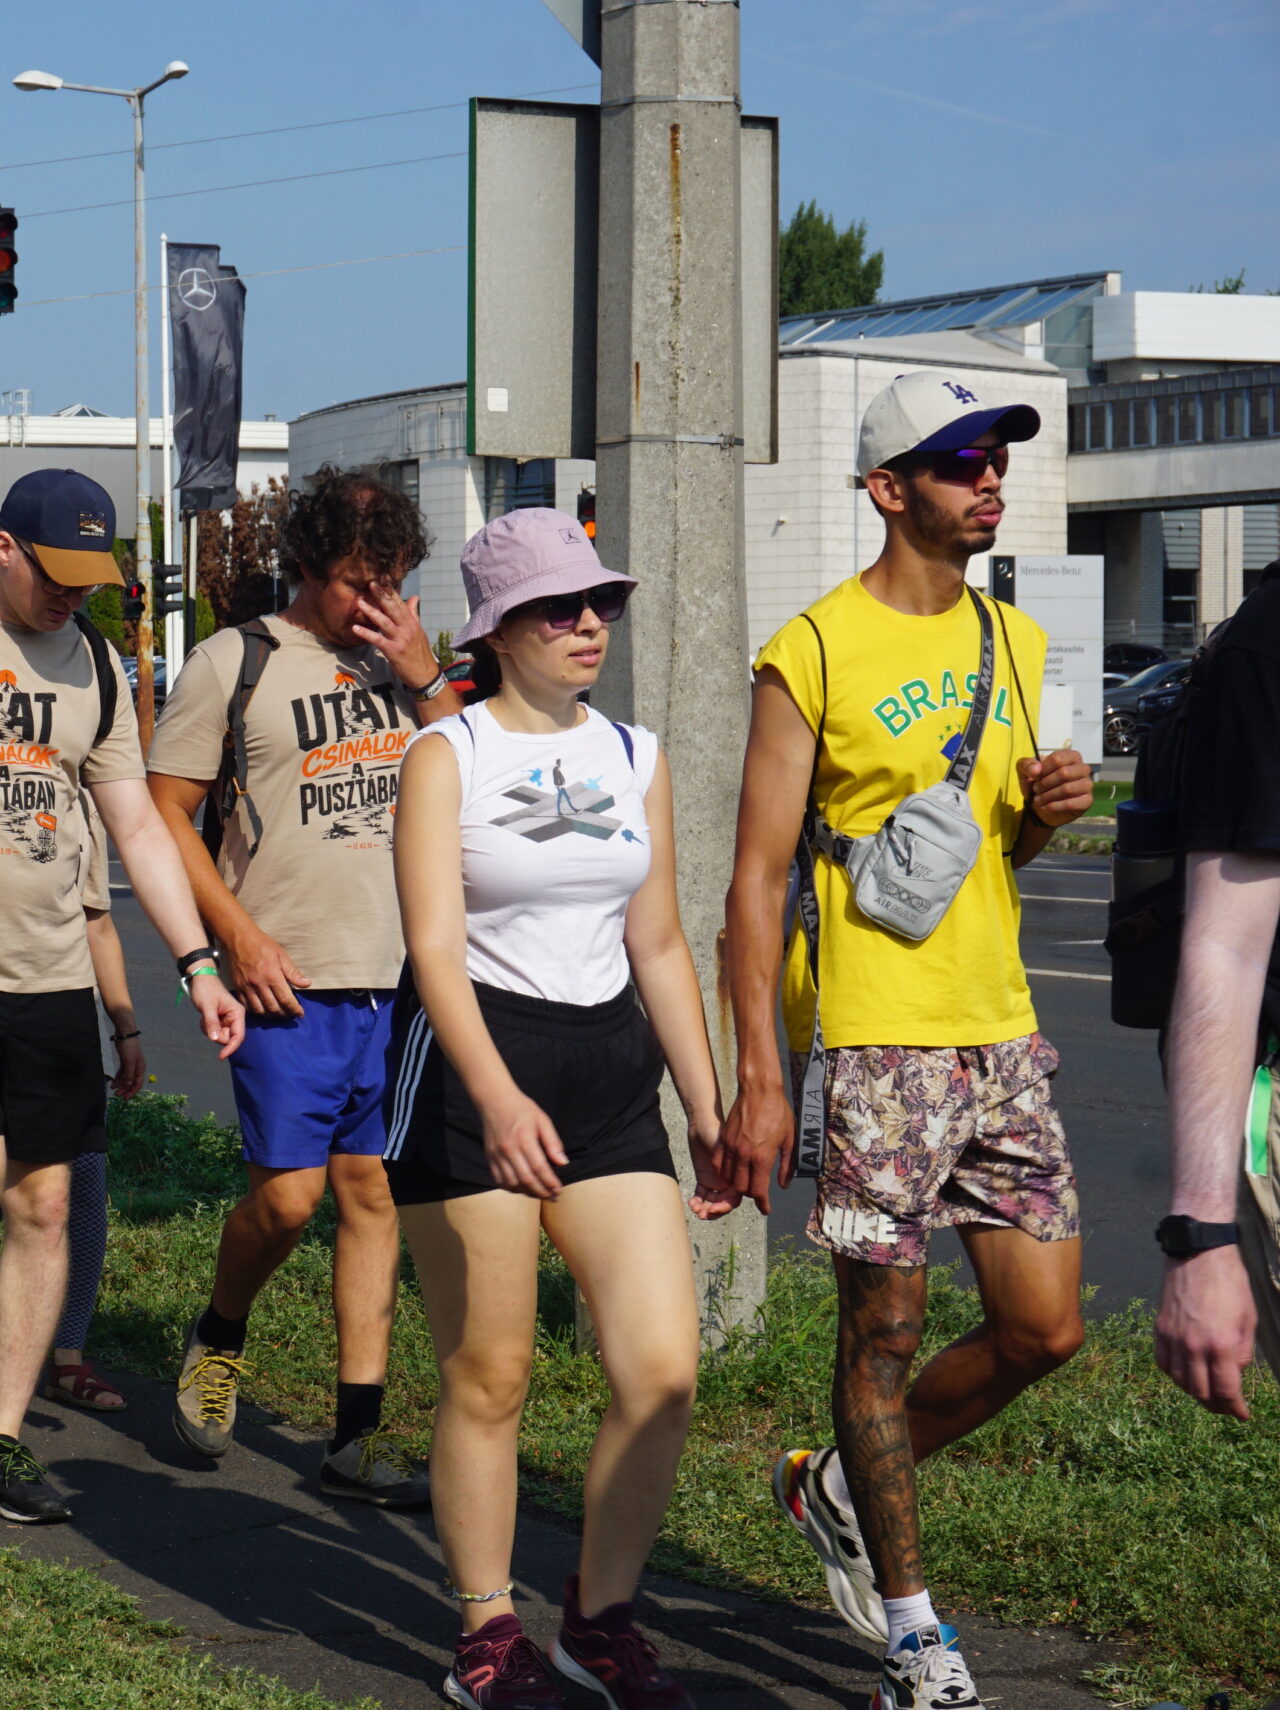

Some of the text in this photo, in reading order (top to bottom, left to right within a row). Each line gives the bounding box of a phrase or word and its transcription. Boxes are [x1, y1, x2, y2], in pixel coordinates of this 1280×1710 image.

[942, 381, 978, 404] LA
[1020, 566, 1082, 577] Mercedes-Benz
[291, 682, 400, 752] UTAT
[873, 671, 1011, 738] BRASL
[302, 731, 412, 778] CSINÁLOK
[352, 762, 365, 779] A
[300, 774, 400, 826] PUSZTÁBA
